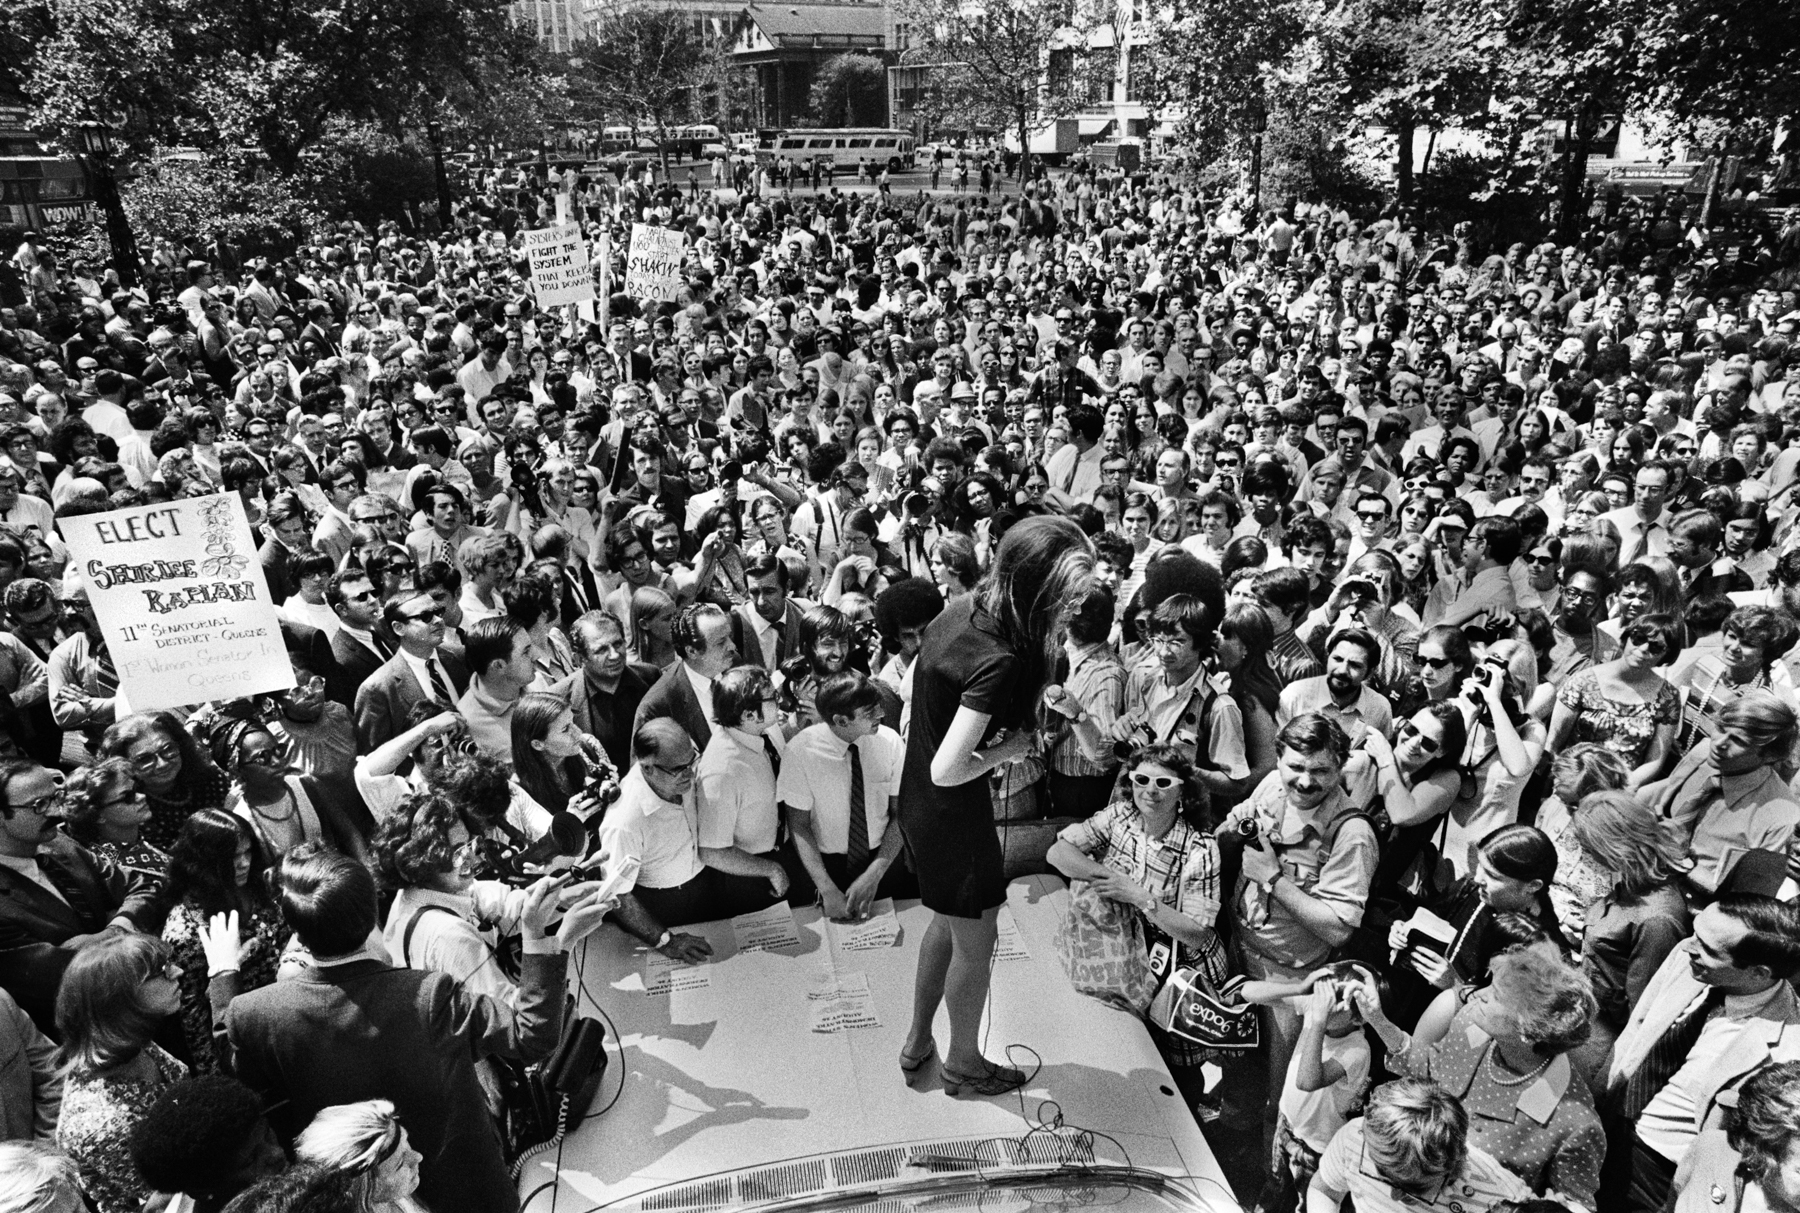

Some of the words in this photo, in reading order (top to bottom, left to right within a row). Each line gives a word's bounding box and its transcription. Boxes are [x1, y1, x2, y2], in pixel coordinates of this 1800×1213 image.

[532, 246, 558, 258] FIGHT
[562, 242, 578, 253] THE
[534, 255, 572, 270] SYSTEM
[538, 272, 558, 282] THAT
[540, 282, 558, 291] YOU
[628, 280, 674, 299] BACON
[94, 508, 182, 544] ELECT
[87, 559, 198, 590] SHIRLEE
[141, 580, 256, 614] KAPLAN
[151, 616, 234, 637] SENATORIAL
[156, 633, 211, 648] DISTRICT
[222, 628, 268, 640] QUEENS
[149, 656, 193, 674] Woman
[197, 649, 254, 666] Senator
[188, 670, 252, 686] Queens
